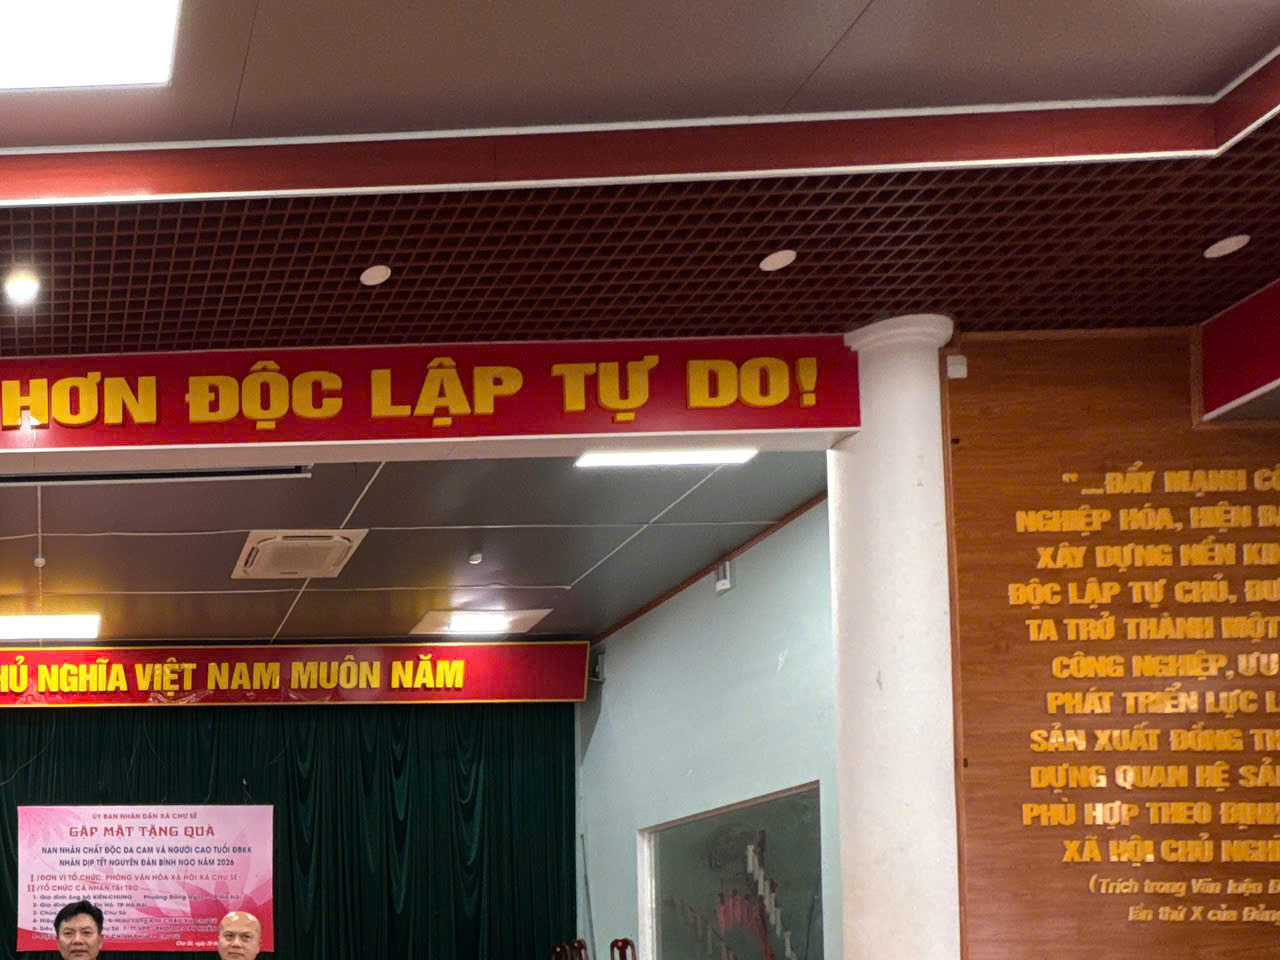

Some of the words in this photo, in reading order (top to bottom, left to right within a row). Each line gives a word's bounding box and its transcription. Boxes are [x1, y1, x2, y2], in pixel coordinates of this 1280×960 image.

[1, 371, 157, 428] HƠN
[184, 361, 343, 431] ĐỘC
[370, 356, 524, 428] LẬP
[552, 355, 660, 423] TỰ
[687, 356, 819, 409] DO!
[1008, 577, 1062, 610] ĐỘC
[1067, 576, 1120, 609] LẬP
[1128, 578, 1168, 608] TỰ
[1025, 619, 1058, 642] TA
[1063, 611, 1117, 641] TRỞ
[36, 658, 129, 693] NGHĨA
[135, 657, 197, 696] VIỆT
[206, 662, 281, 690] NAM
[289, 655, 382, 690] MUÔN
[391, 654, 465, 690] NĂM
[1046, 687, 1114, 714] PHÁT
[1122, 682, 1199, 714] TRIỂN
[1205, 688, 1259, 719] LỰC
[1030, 722, 1087, 752] SẢN
[1094, 721, 1162, 752] XUẤT
[1115, 765, 1189, 790] QUAN
[69, 824, 98, 840] GẶP
[103, 824, 132, 840] MẶT
[138, 823, 180, 839] TẶNG
[184, 823, 215, 838] QUÀ
[123, 846, 135, 854] DA
[135, 846, 154, 854] CAM
[194, 845, 212, 854] CAO
[216, 858, 235, 867] 2026
